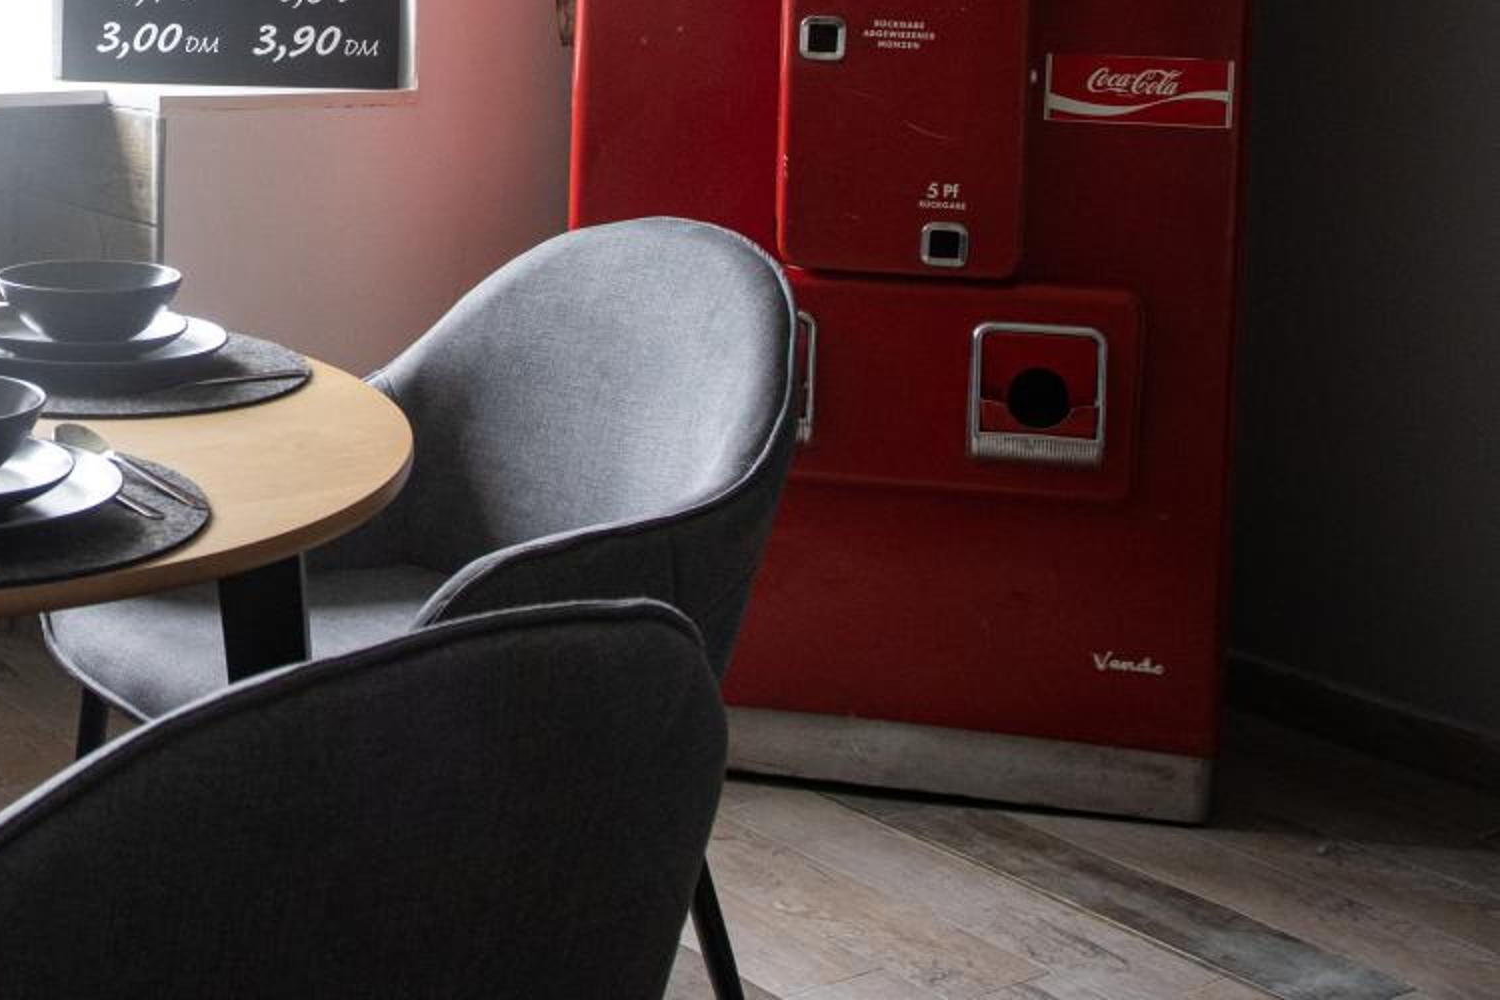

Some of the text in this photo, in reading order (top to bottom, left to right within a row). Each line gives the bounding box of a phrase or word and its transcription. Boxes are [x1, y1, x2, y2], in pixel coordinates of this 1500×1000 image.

[96, 21, 220, 59] 3,00 DM
[253, 25, 379, 62] 3,90 DM
[1086, 66, 1183, 96] Coca-Cola
[926, 182, 960, 199] 5 Pf
